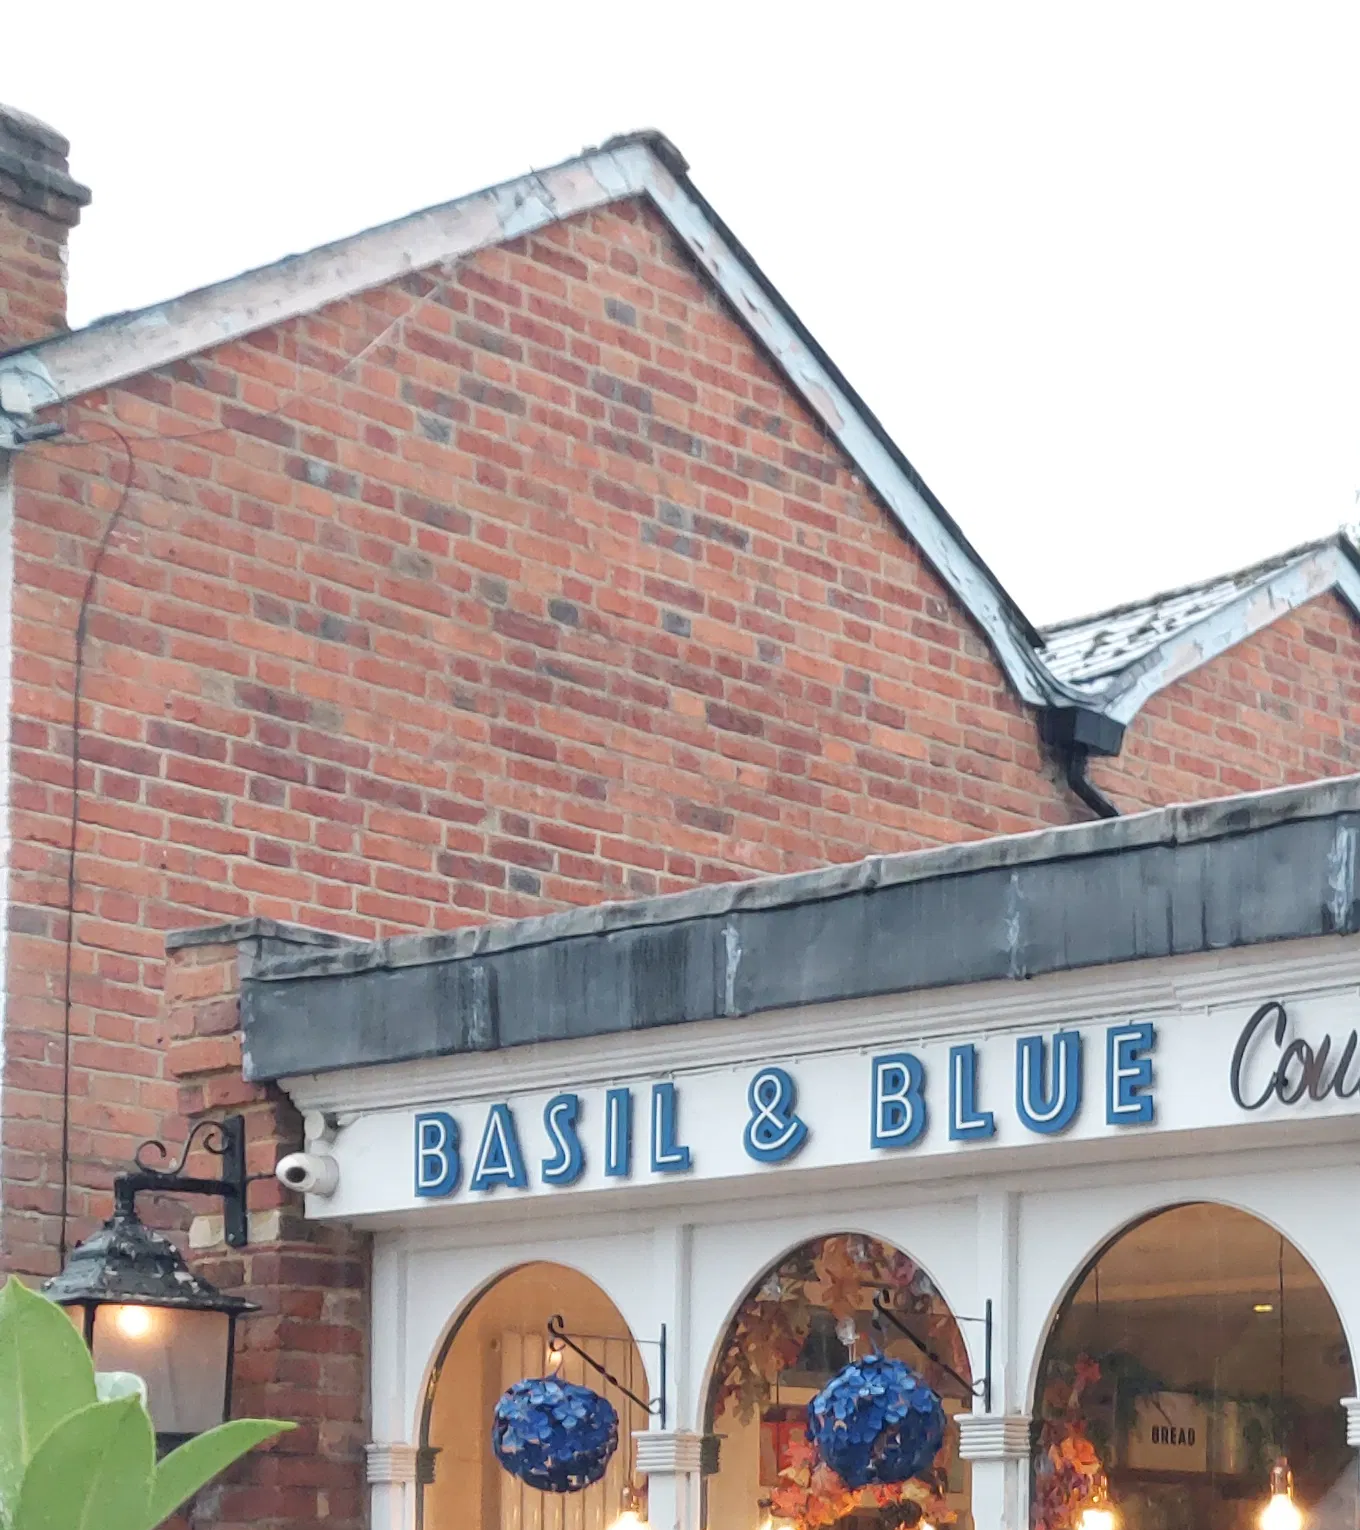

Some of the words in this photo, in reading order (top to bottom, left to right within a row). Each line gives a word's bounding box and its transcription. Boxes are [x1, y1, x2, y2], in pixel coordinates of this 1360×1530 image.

[414, 1082, 690, 1197] BASIL
[743, 1066, 807, 1162] &
[871, 1022, 1156, 1149] BLUE
[1152, 1425, 1195, 1446] BREAD
